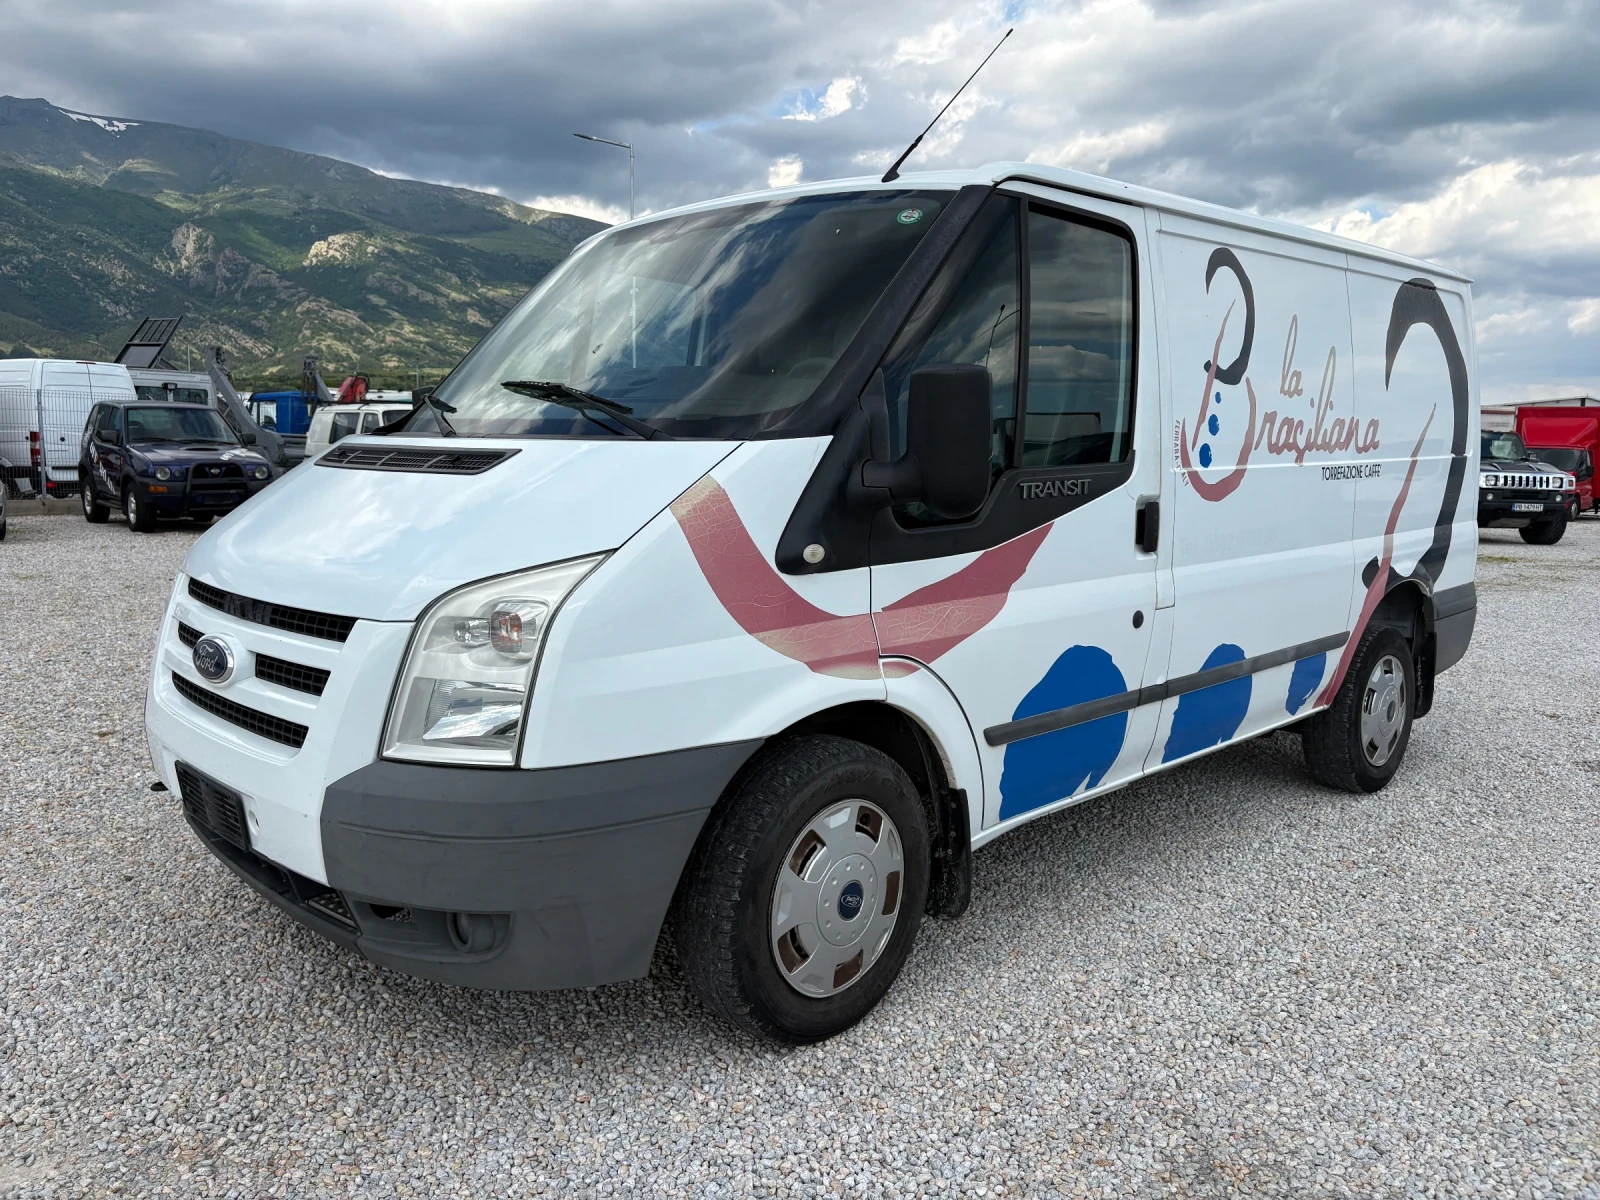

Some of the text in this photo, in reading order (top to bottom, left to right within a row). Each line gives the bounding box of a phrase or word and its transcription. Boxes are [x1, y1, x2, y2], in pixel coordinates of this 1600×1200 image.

[1321, 465, 1363, 480] TORREFAZIONE
[1020, 479, 1091, 499] TRANSIT
[195, 644, 218, 672] Ford
